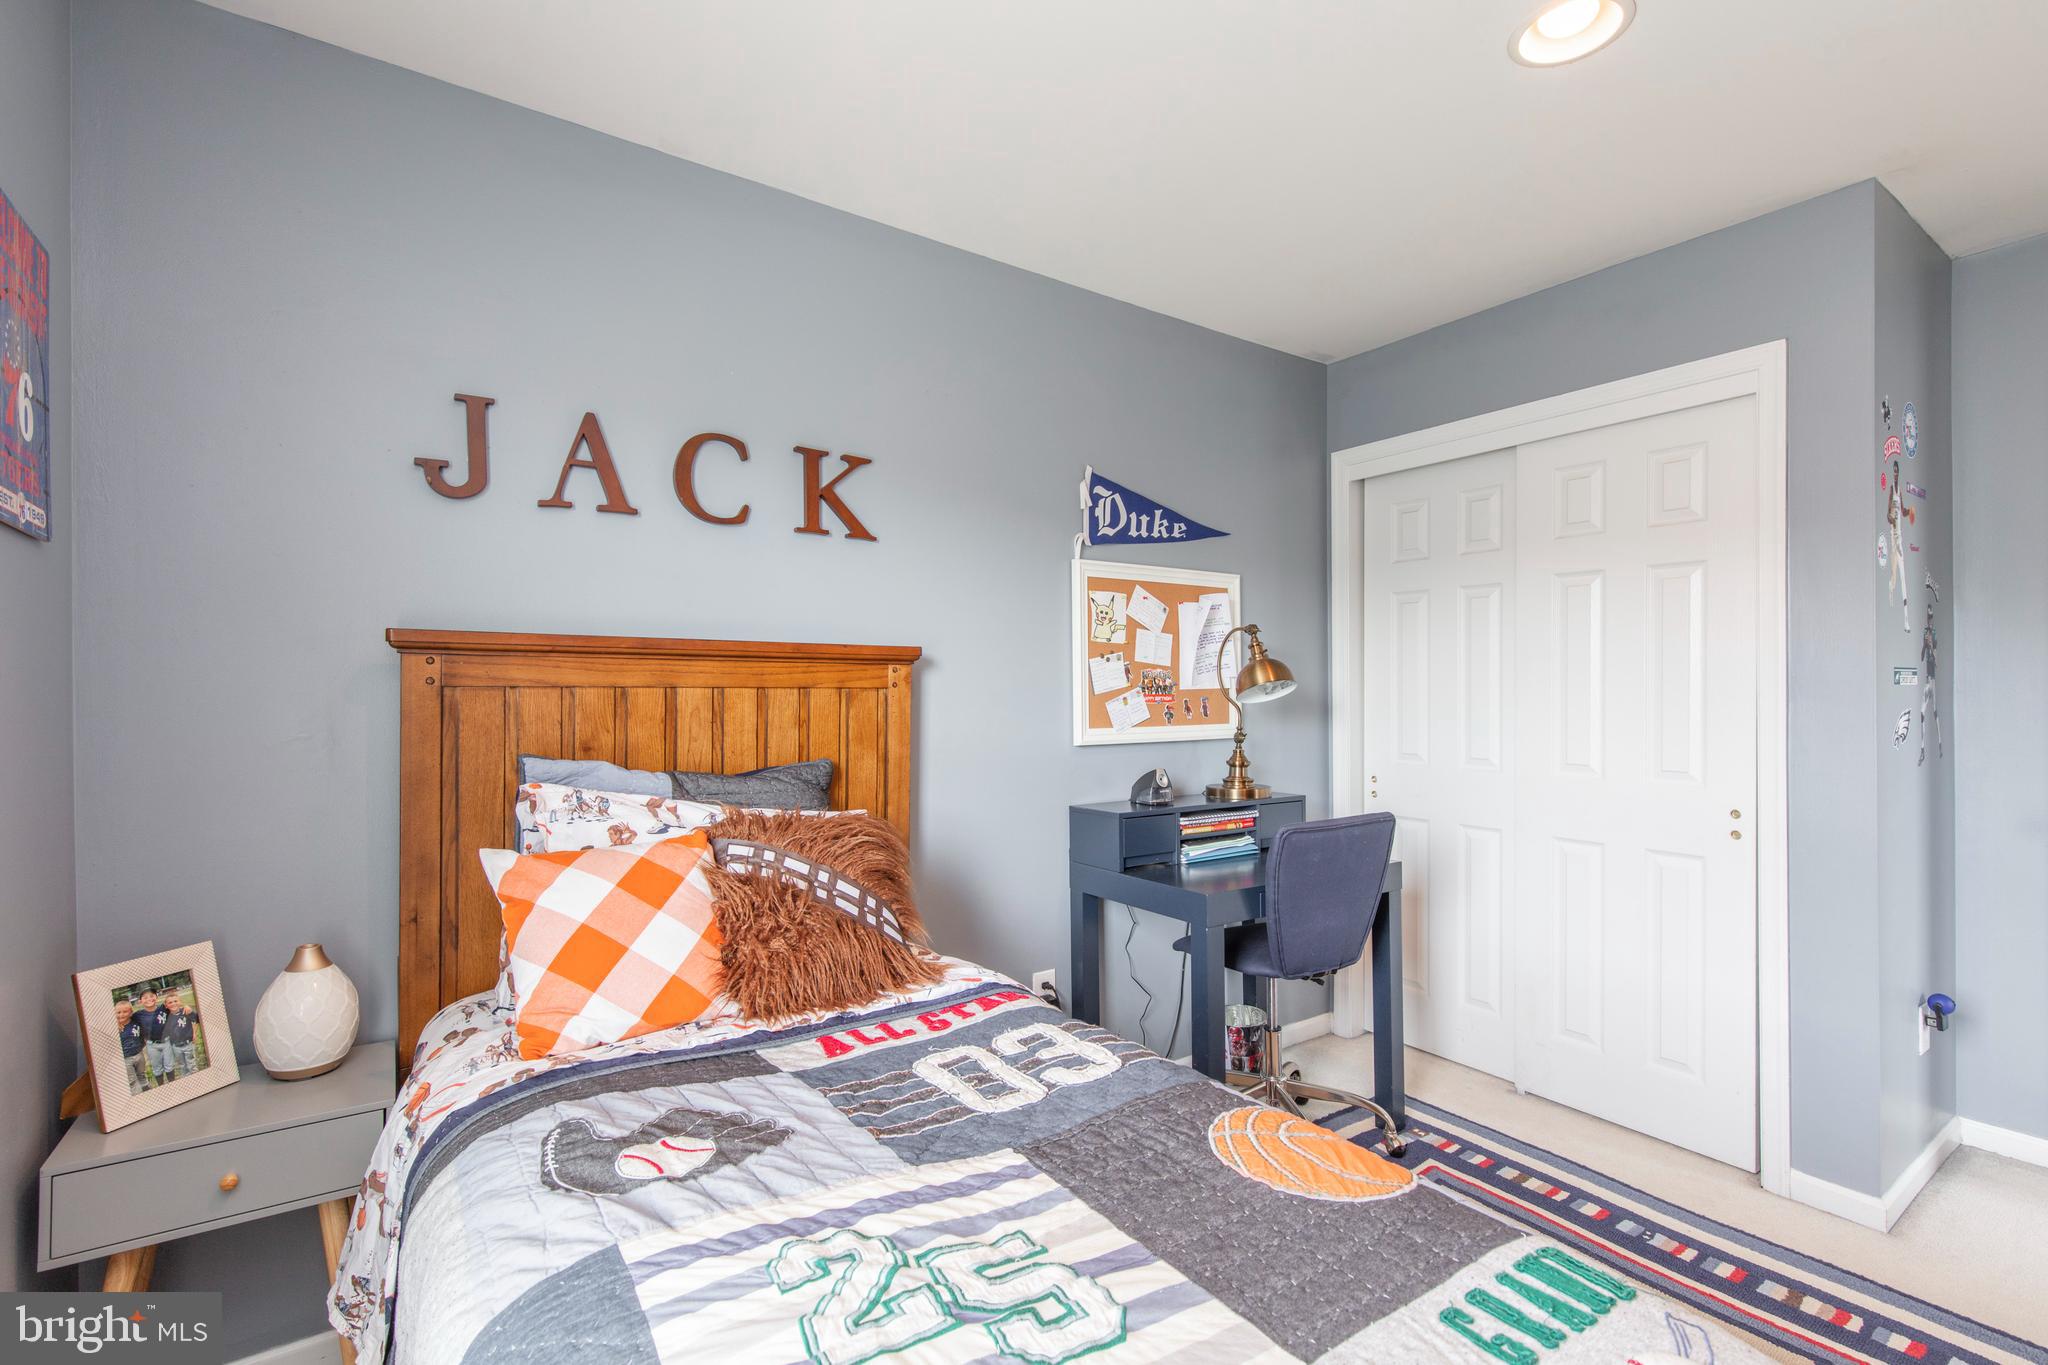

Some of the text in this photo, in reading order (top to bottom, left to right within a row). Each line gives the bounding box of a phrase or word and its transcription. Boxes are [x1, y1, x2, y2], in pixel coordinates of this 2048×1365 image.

[414, 393, 877, 542] JACK
[1093, 485, 1187, 538] Duke
[815, 991, 1031, 1059] ALL STAR
[911, 1022, 1122, 1113] 03
[766, 1229, 1127, 1365] 25
[1439, 1246, 1637, 1365] GRAND
